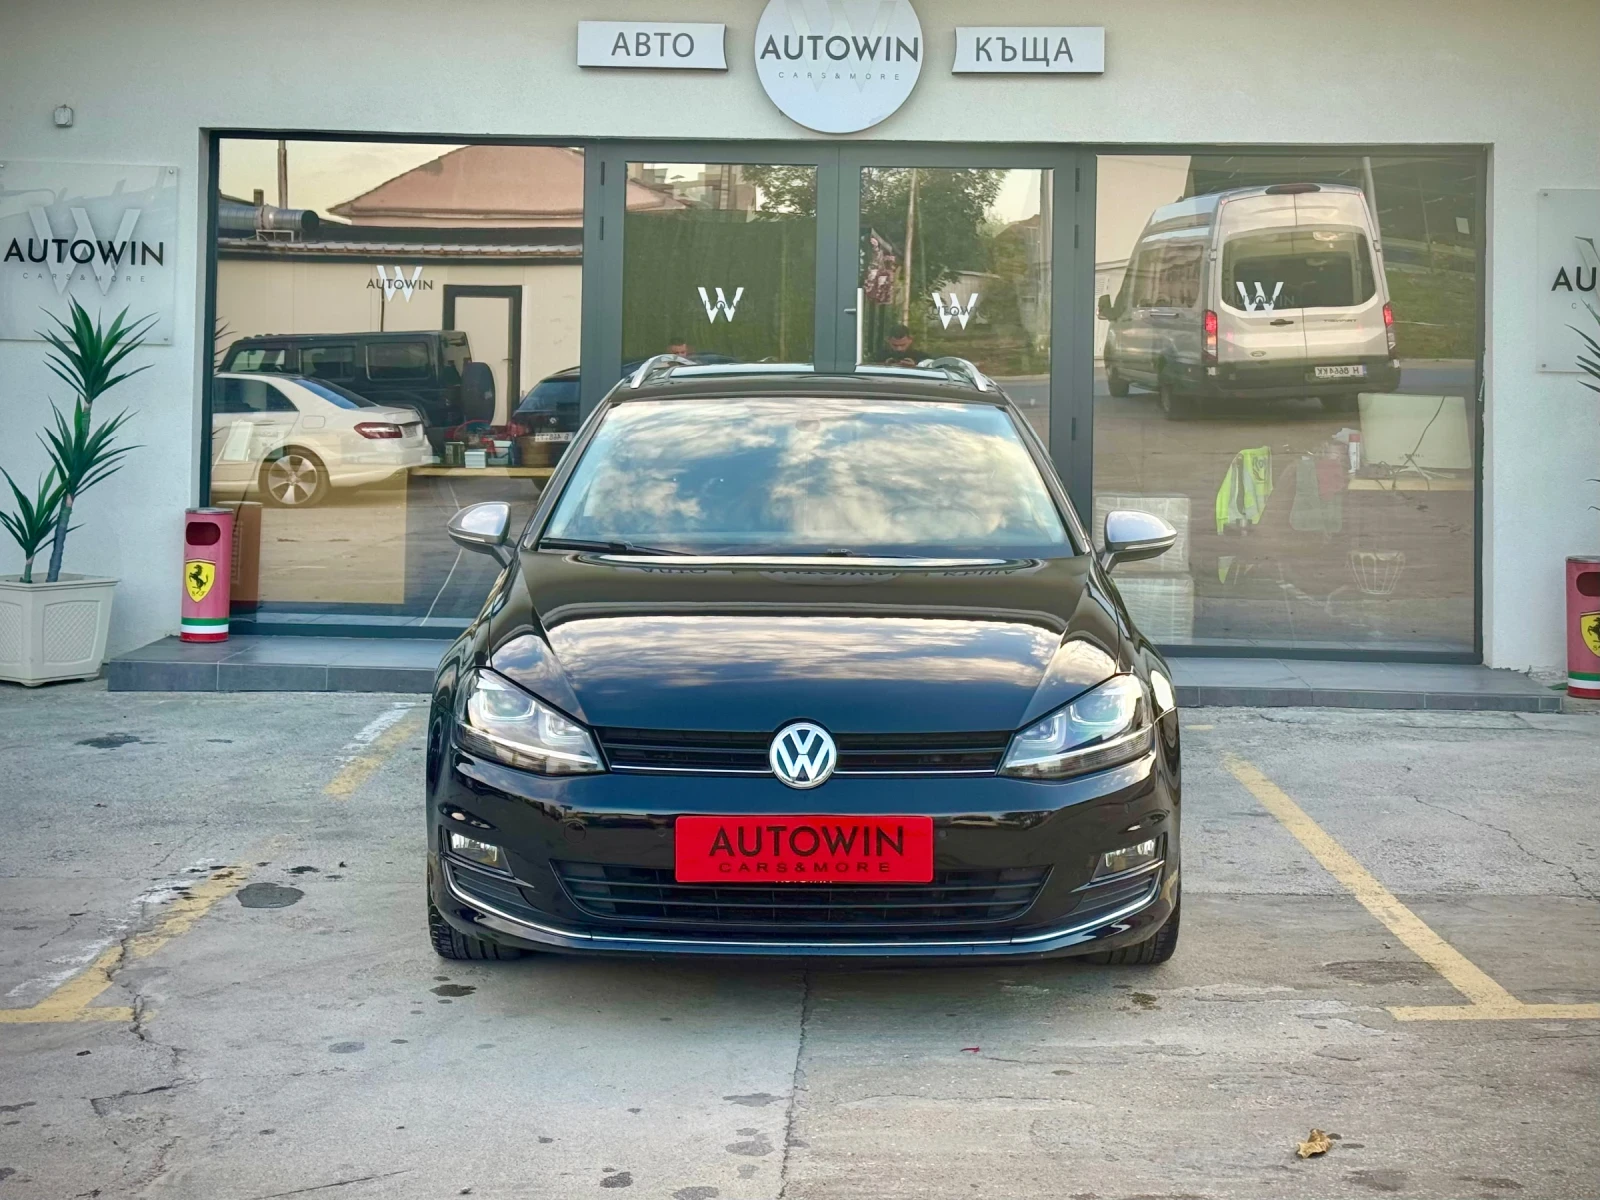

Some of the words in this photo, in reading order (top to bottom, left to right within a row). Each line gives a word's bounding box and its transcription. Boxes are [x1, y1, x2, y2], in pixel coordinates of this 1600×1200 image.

[611, 31, 695, 58] АВТО
[760, 34, 919, 62] AUTOWIN
[975, 36, 1074, 67] КЪЩА
[3, 237, 164, 267] AUTOWIN
[366, 278, 433, 291] AUTOWIN
[709, 826, 904, 857] AUTOWIN
[719, 862, 890, 873] CARS&MORE
